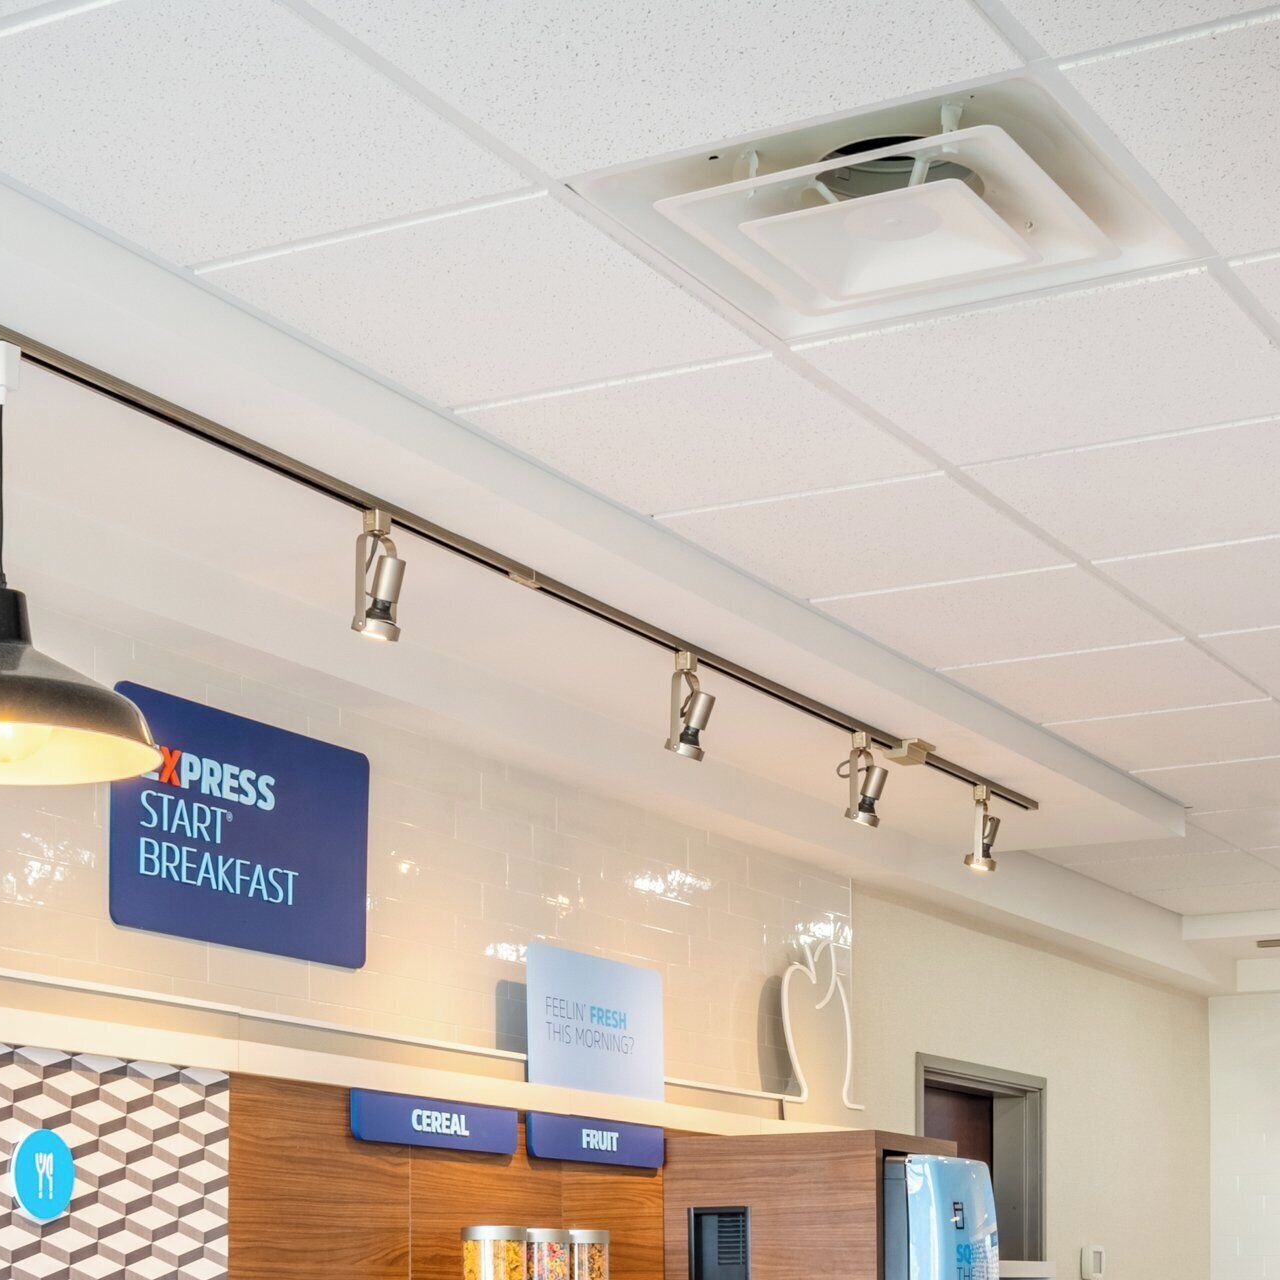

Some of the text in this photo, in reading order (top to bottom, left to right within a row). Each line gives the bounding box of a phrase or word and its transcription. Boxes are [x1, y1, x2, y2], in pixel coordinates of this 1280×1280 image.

[139, 837, 299, 905] BREAKFAST
[590, 1006, 627, 1030] FRESH
[545, 1022, 634, 1055] THIS MORNING?
[411, 1108, 470, 1137] CEREAL
[582, 1129, 619, 1152] FRUIT
